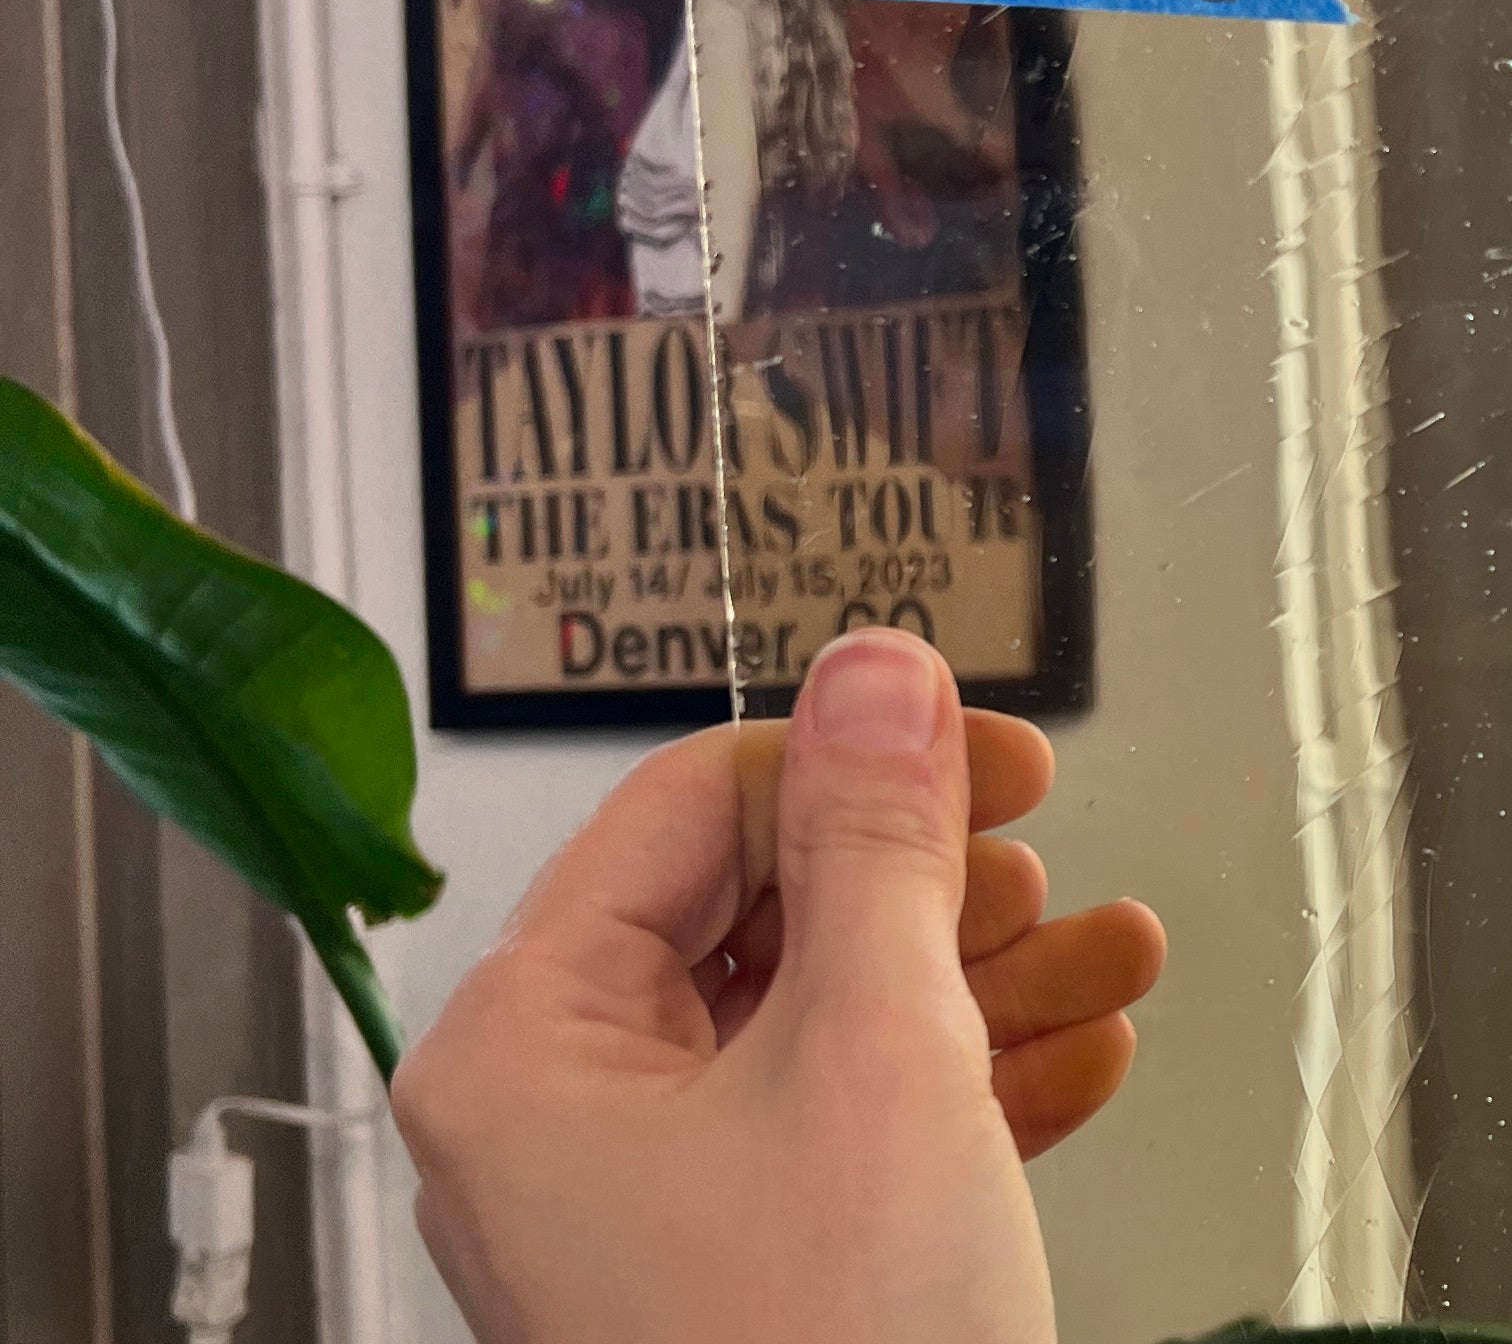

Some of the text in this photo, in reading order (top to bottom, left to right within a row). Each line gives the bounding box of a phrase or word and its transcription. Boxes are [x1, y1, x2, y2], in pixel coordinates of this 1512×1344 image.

[468, 490, 610, 564] THE
[532, 567, 615, 610] July
[705, 559, 780, 603] July
[856, 550, 953, 592] 2023
